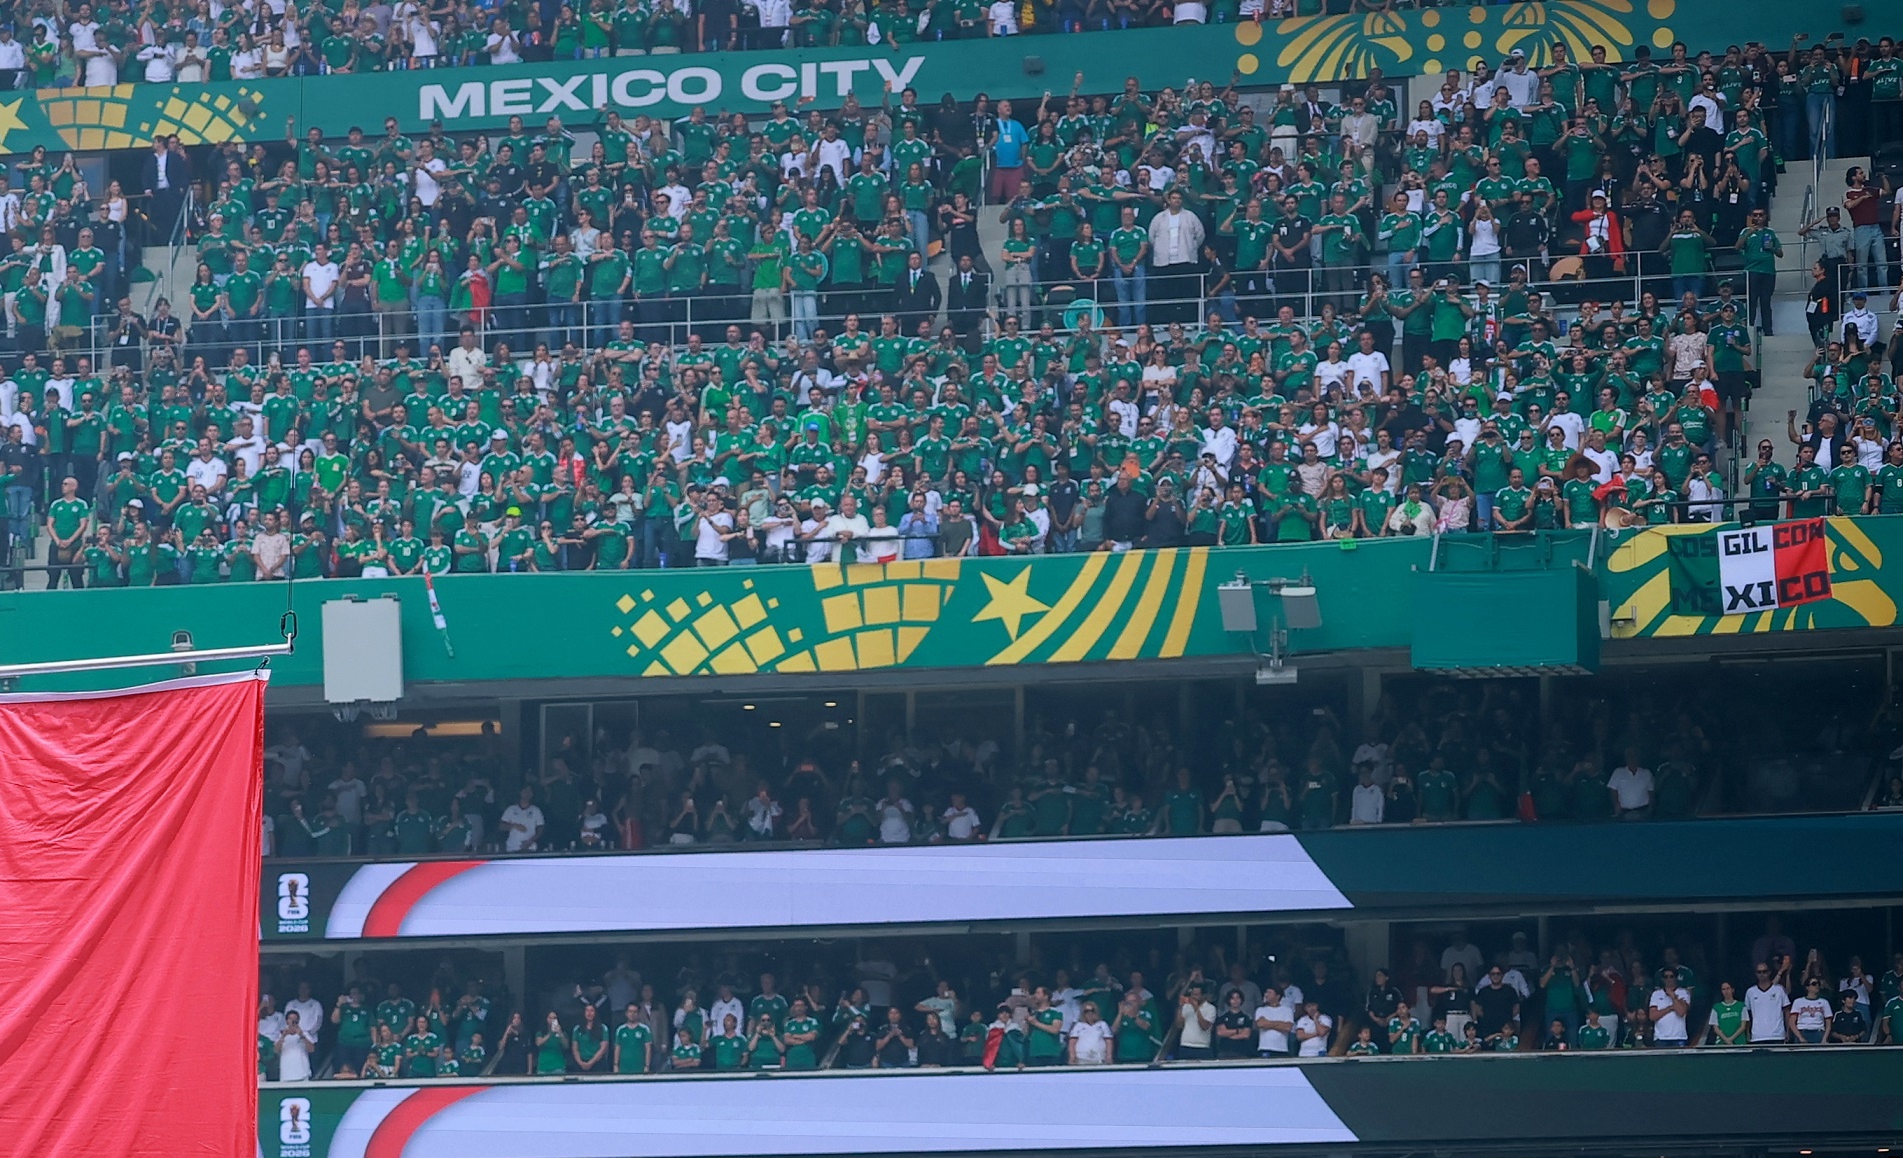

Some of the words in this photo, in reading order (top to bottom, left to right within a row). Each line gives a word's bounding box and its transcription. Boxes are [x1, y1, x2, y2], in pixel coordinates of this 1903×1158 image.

[419, 68, 722, 121] MEXICO
[741, 56, 925, 101] CITY
[1575, 382, 1581, 392] 9
[1802, 481, 1808, 490] 11
[1654, 504, 1666, 514] 34
[1723, 531, 1769, 556] GIL
